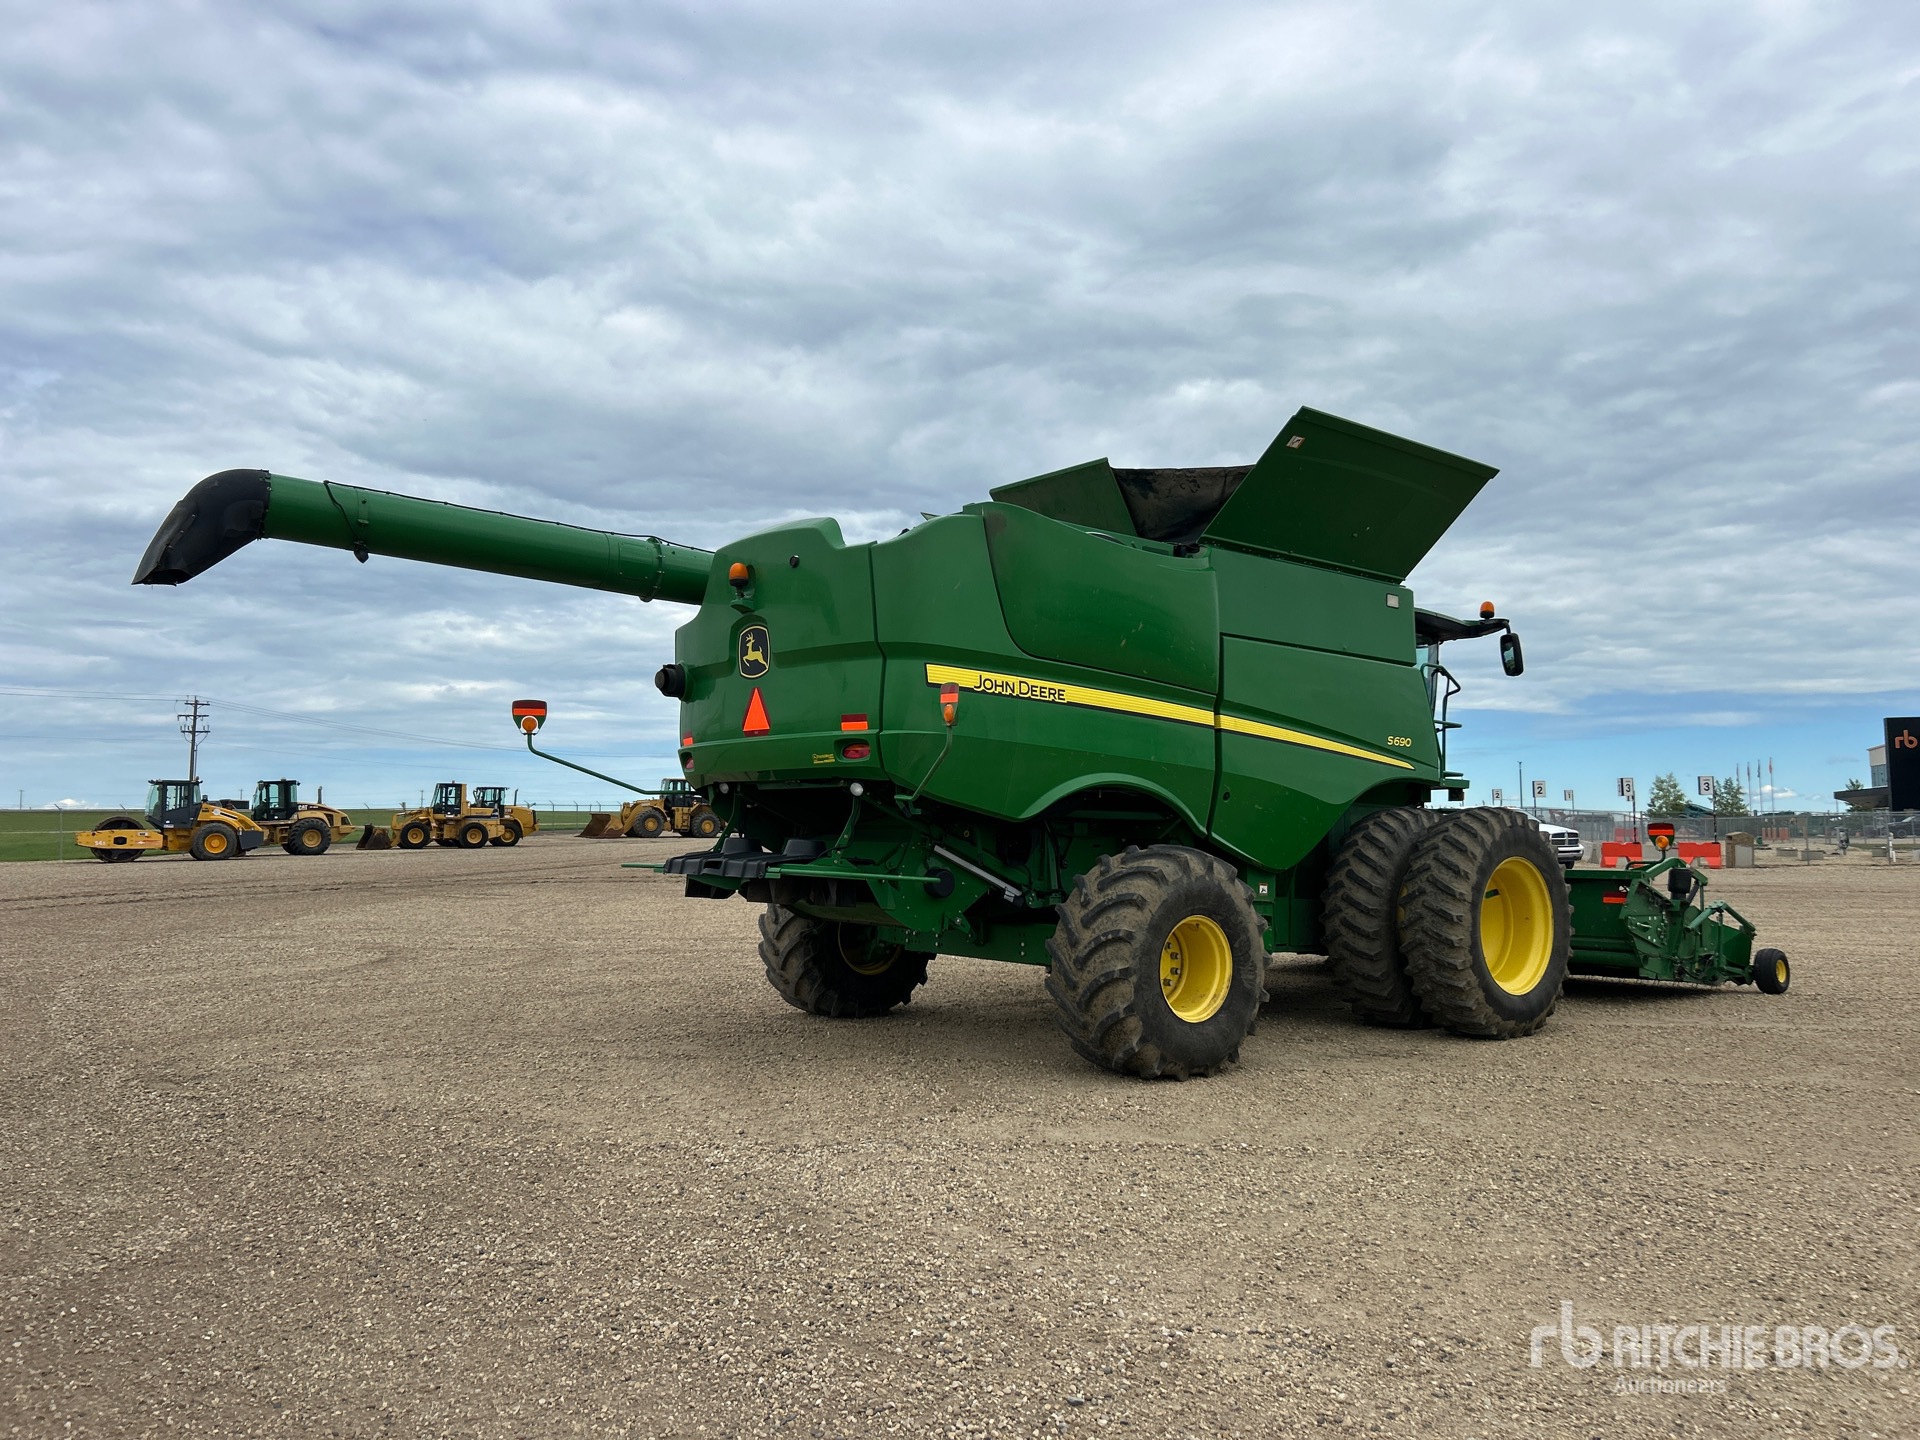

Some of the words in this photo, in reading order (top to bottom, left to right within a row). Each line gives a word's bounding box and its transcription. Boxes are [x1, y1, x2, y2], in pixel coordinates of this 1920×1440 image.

[974, 674, 1015, 694] JOHN
[1018, 681, 1067, 701] DEERE
[1386, 735, 1412, 747] S690
[1894, 729, 1918, 749] rb
[1536, 785, 1543, 795] 2
[1625, 783, 1631, 793] 3
[1703, 781, 1710, 792] 3
